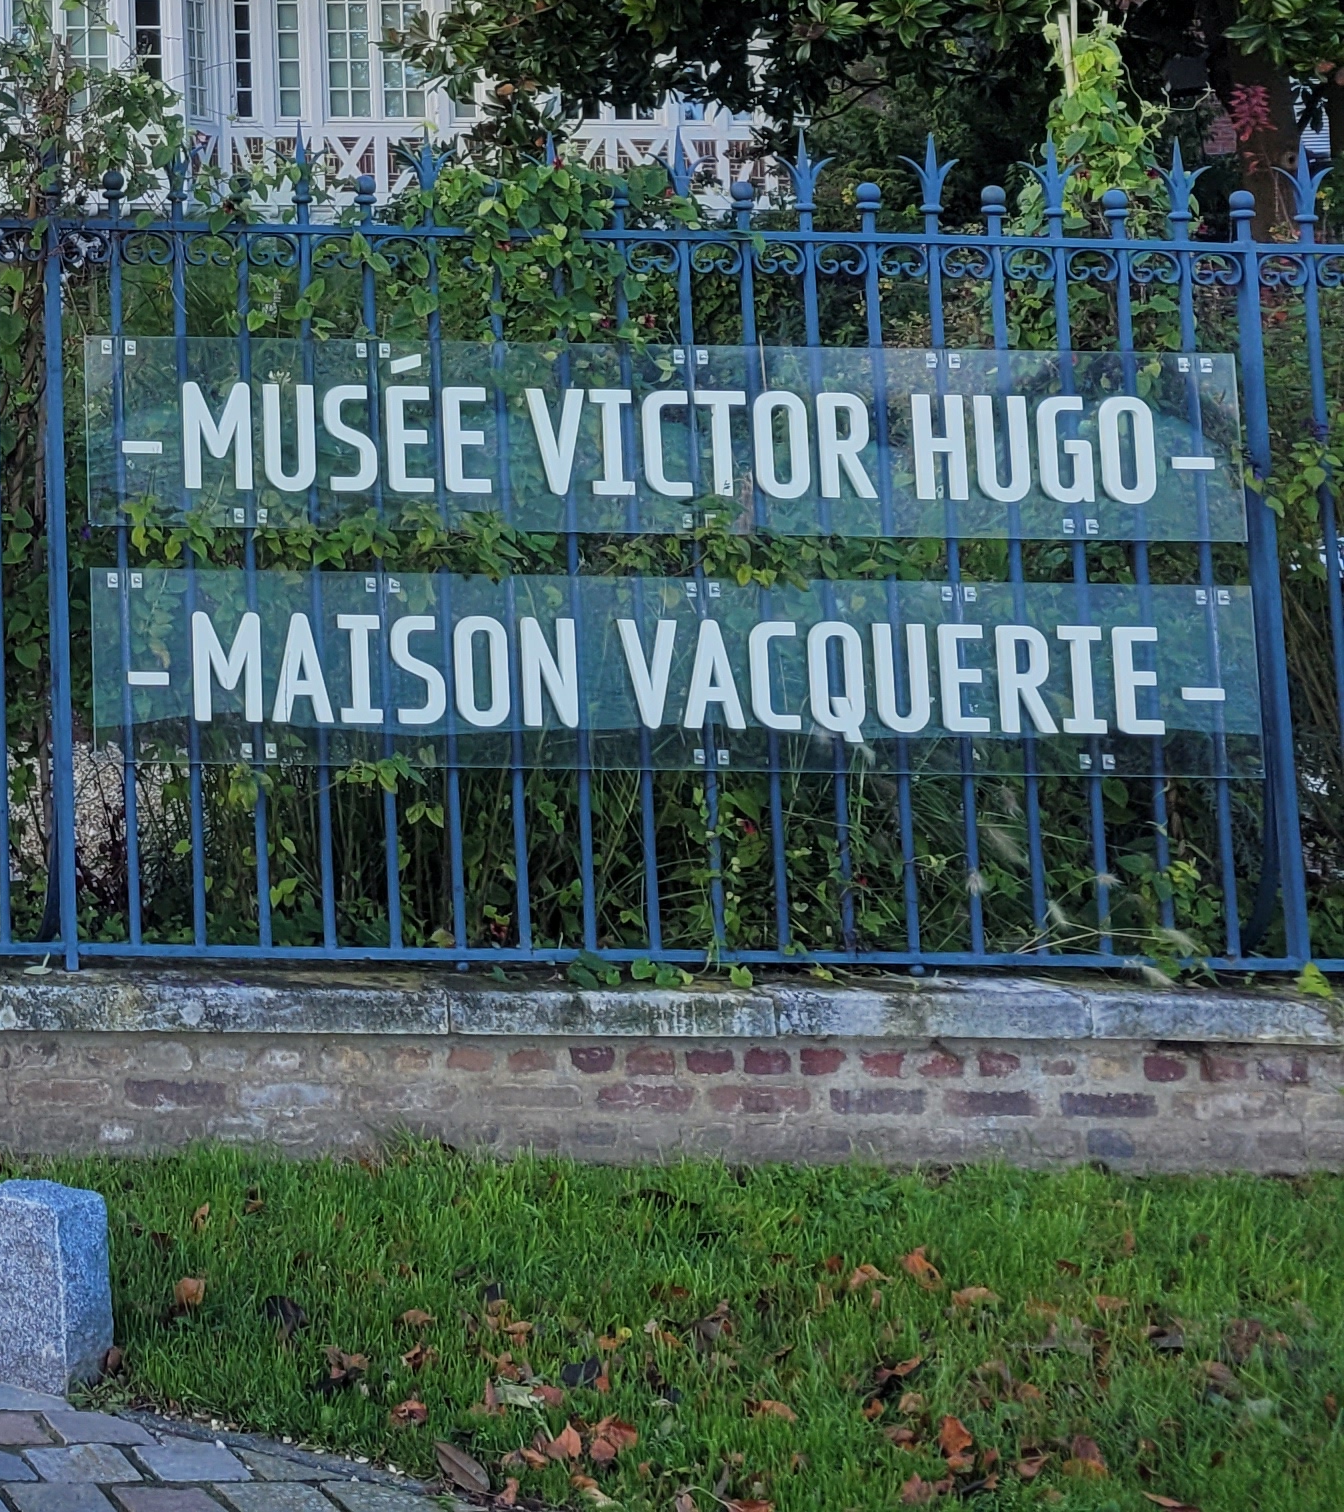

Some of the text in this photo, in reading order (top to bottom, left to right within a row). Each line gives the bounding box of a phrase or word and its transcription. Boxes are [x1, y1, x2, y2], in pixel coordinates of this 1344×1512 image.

[182, 353, 1157, 505] MUSÉE VICTOR HUGO
[191, 611, 1166, 743] MAISON VACQUERIE
